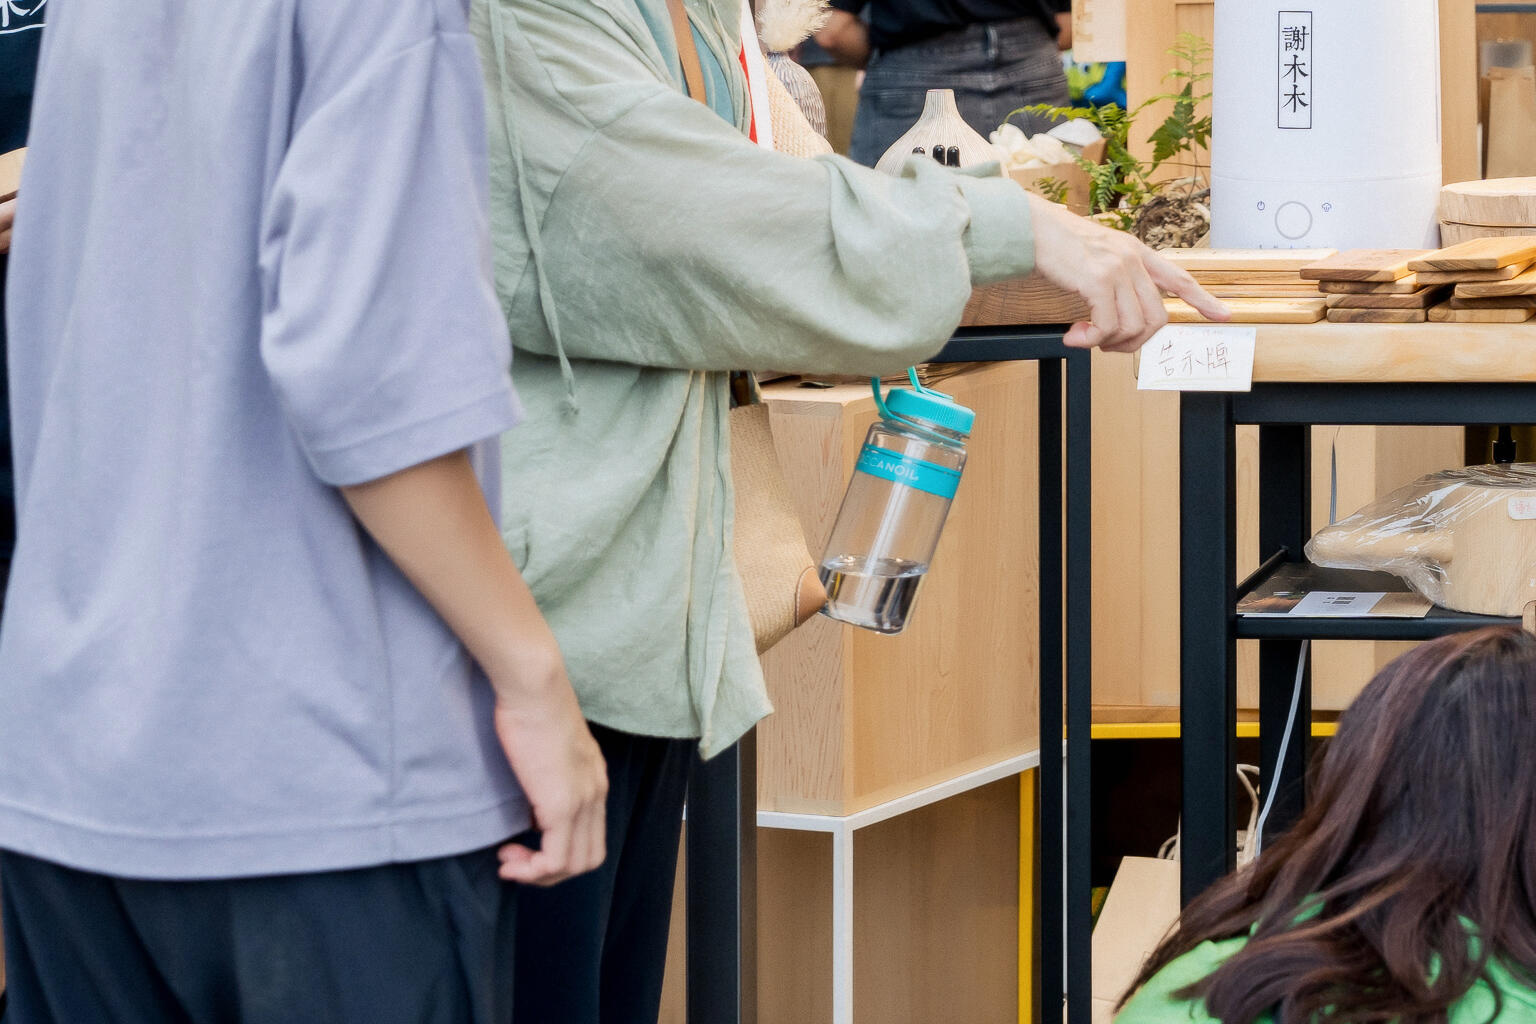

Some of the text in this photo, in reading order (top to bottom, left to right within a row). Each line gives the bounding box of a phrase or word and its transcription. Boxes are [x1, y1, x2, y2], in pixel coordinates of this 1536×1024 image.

[1281, 25, 1309, 114] 謝木木
[1158, 339, 1231, 377] 告示牌
